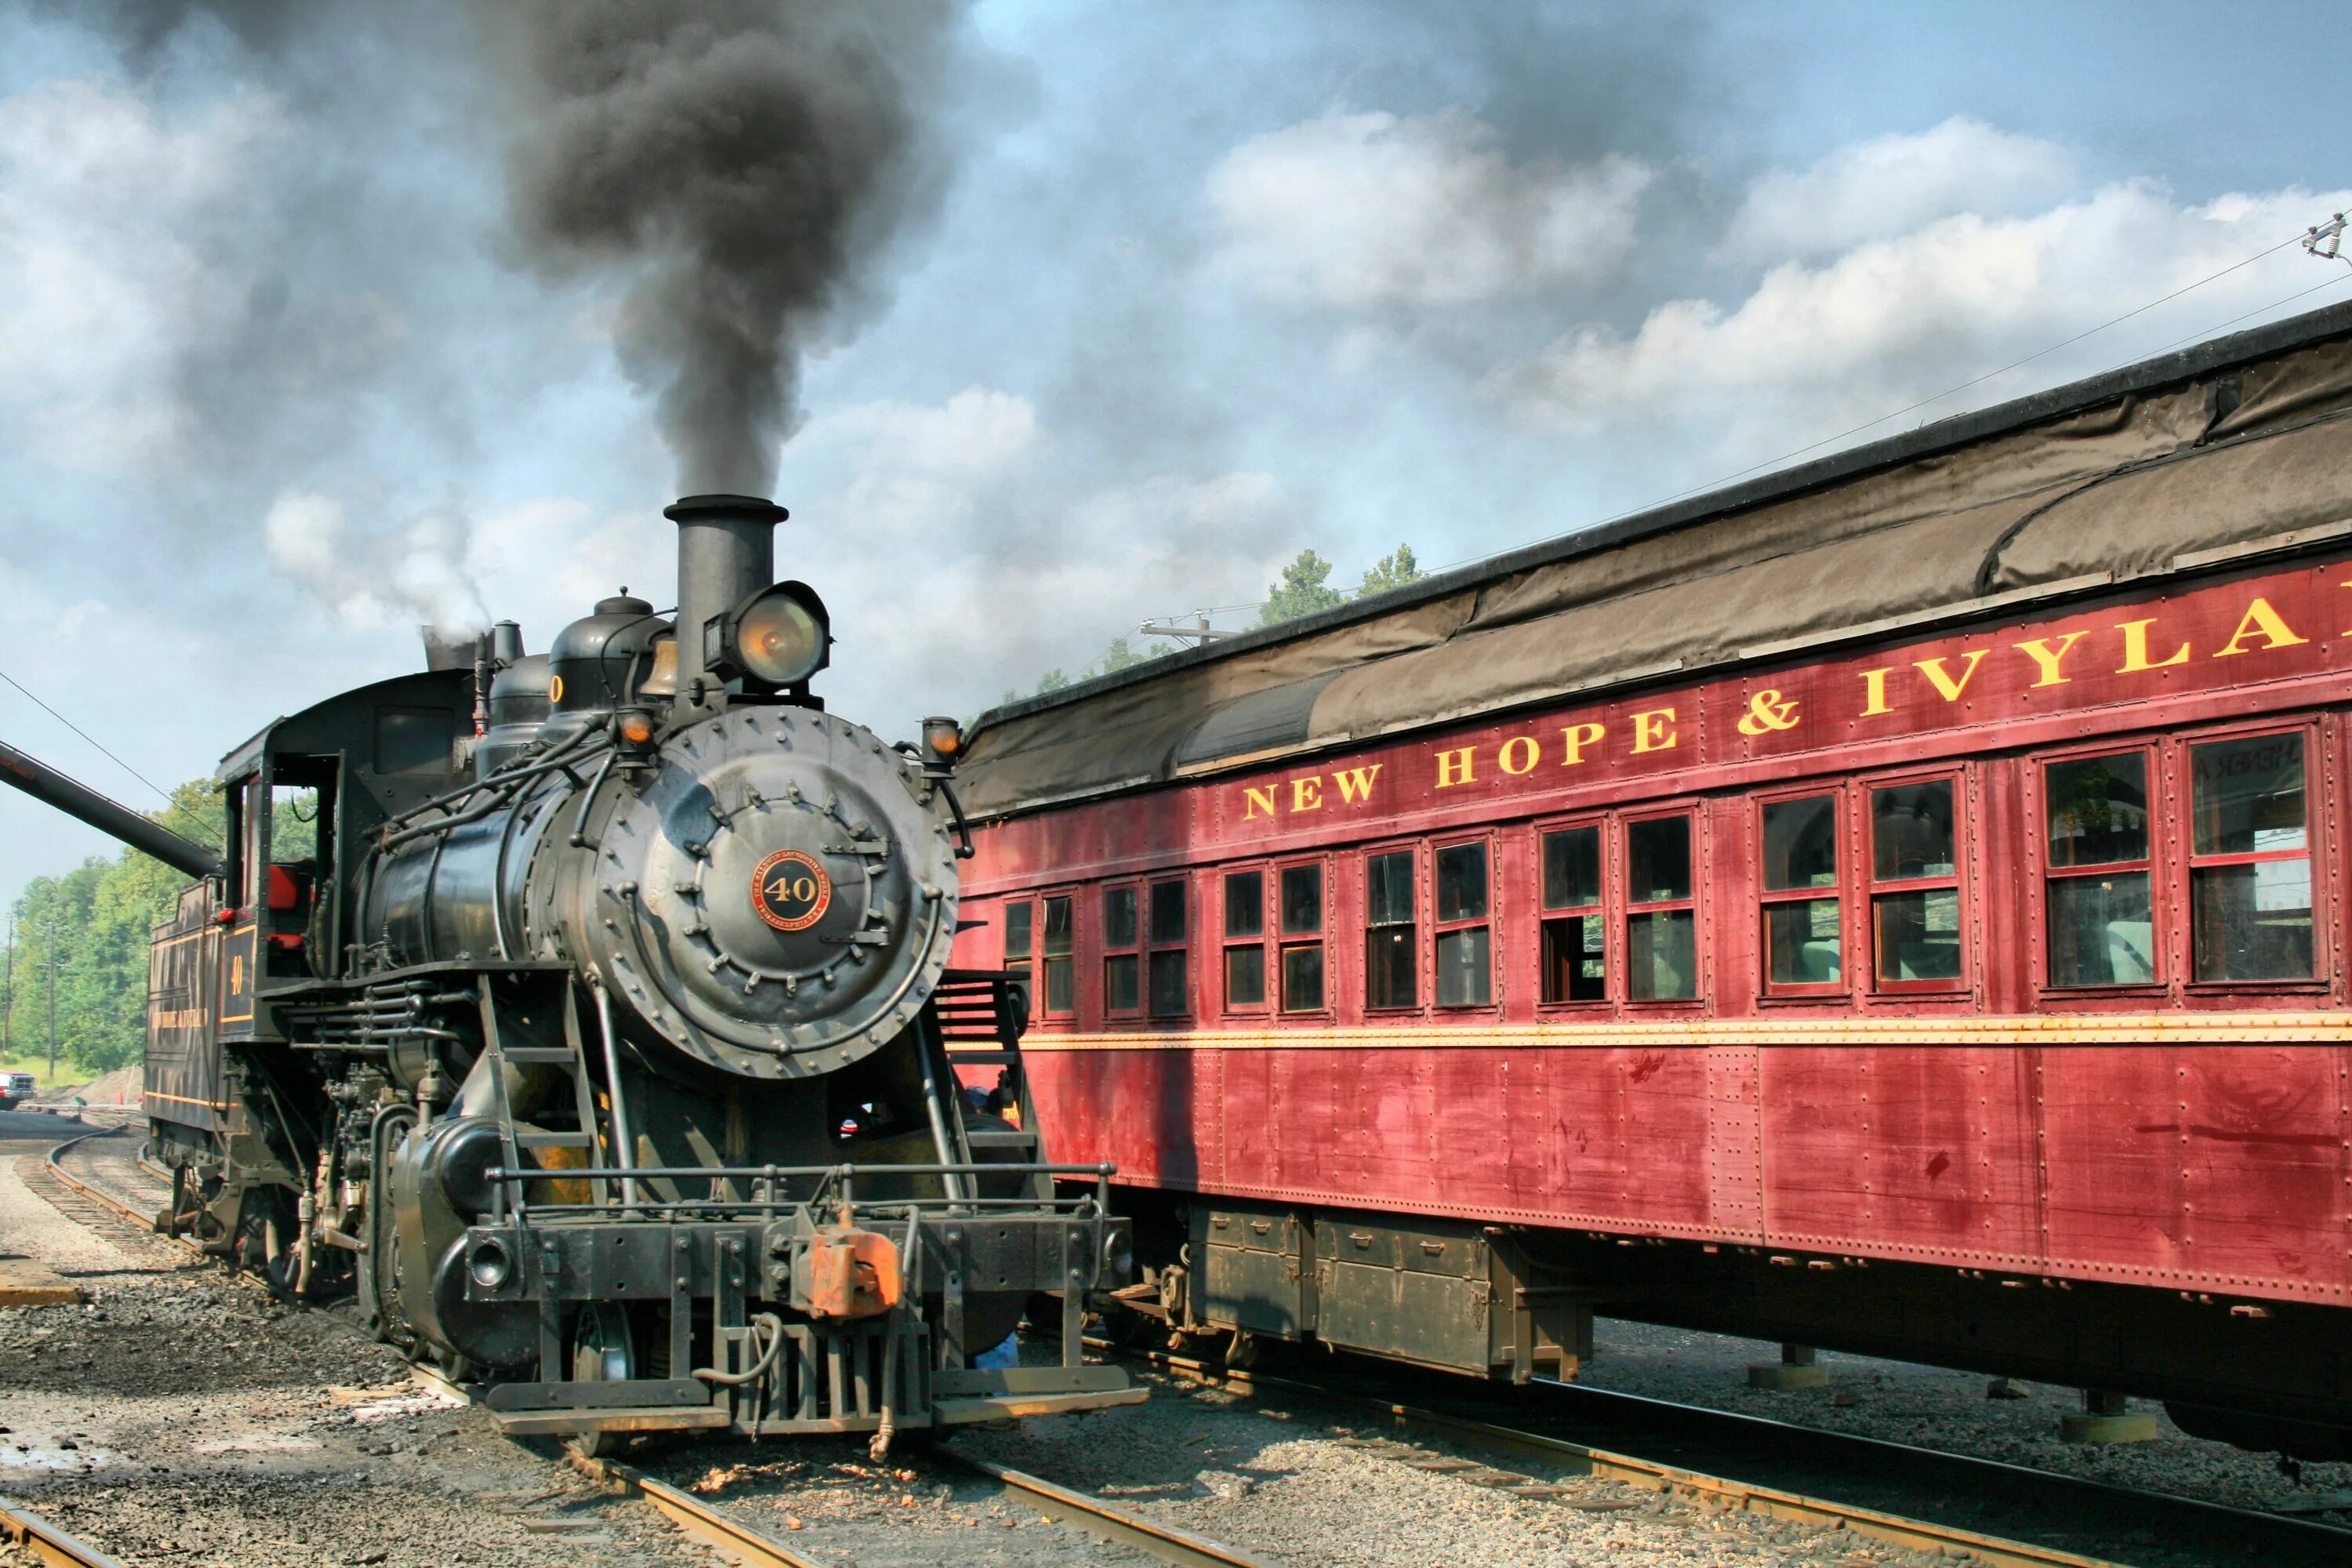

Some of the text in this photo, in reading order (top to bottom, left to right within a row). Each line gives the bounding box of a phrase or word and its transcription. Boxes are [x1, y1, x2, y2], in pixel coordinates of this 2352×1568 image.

[1243, 580, 2352, 821] NEW HOPE & IVYLA
[764, 877, 817, 902] 40
[231, 954, 242, 996] 40
